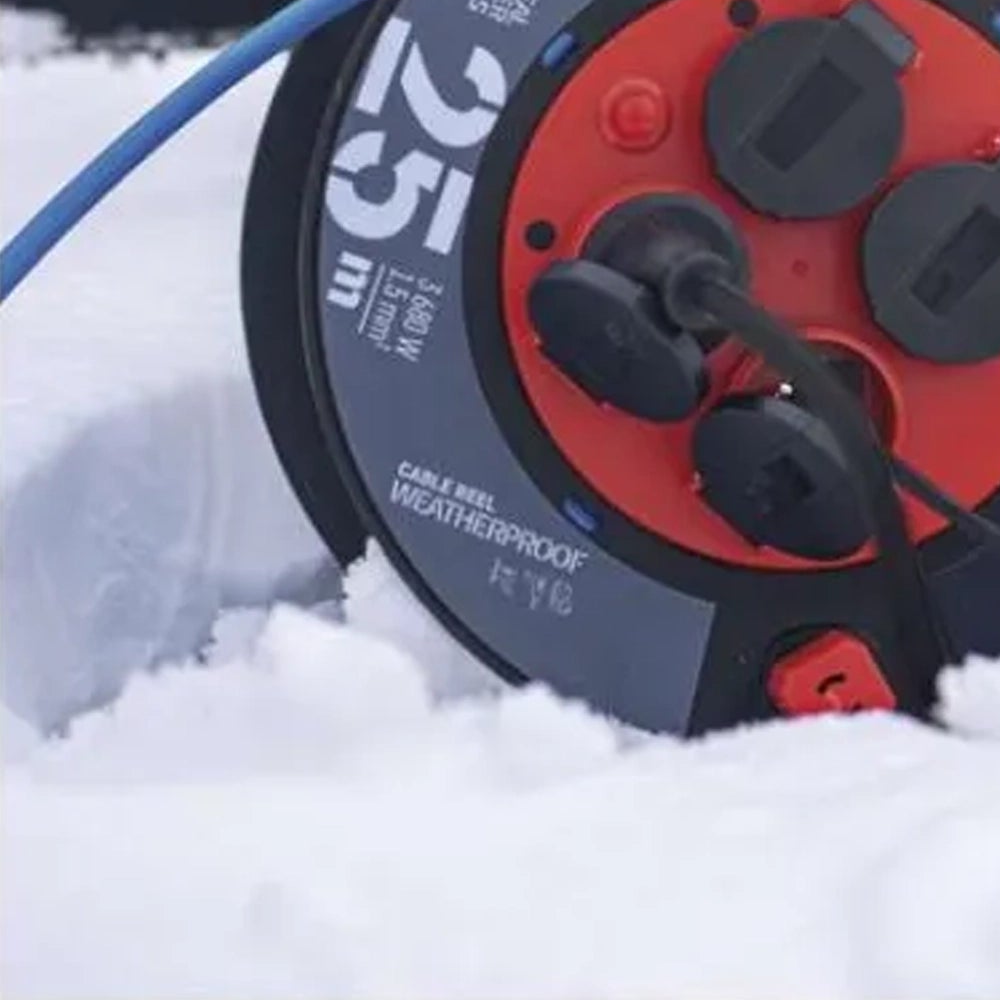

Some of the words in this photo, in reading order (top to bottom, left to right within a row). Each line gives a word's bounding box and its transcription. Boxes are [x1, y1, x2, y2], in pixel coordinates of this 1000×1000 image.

[325, 16, 507, 256] 25
[327, 251, 373, 310] m
[383, 267, 415, 302] 1.5
[417, 277, 444, 296] 3
[402, 293, 434, 334] 680
[396, 336, 424, 362] W
[398, 460, 454, 496] CABLE
[390, 479, 589, 576] WEATHERPROOF
